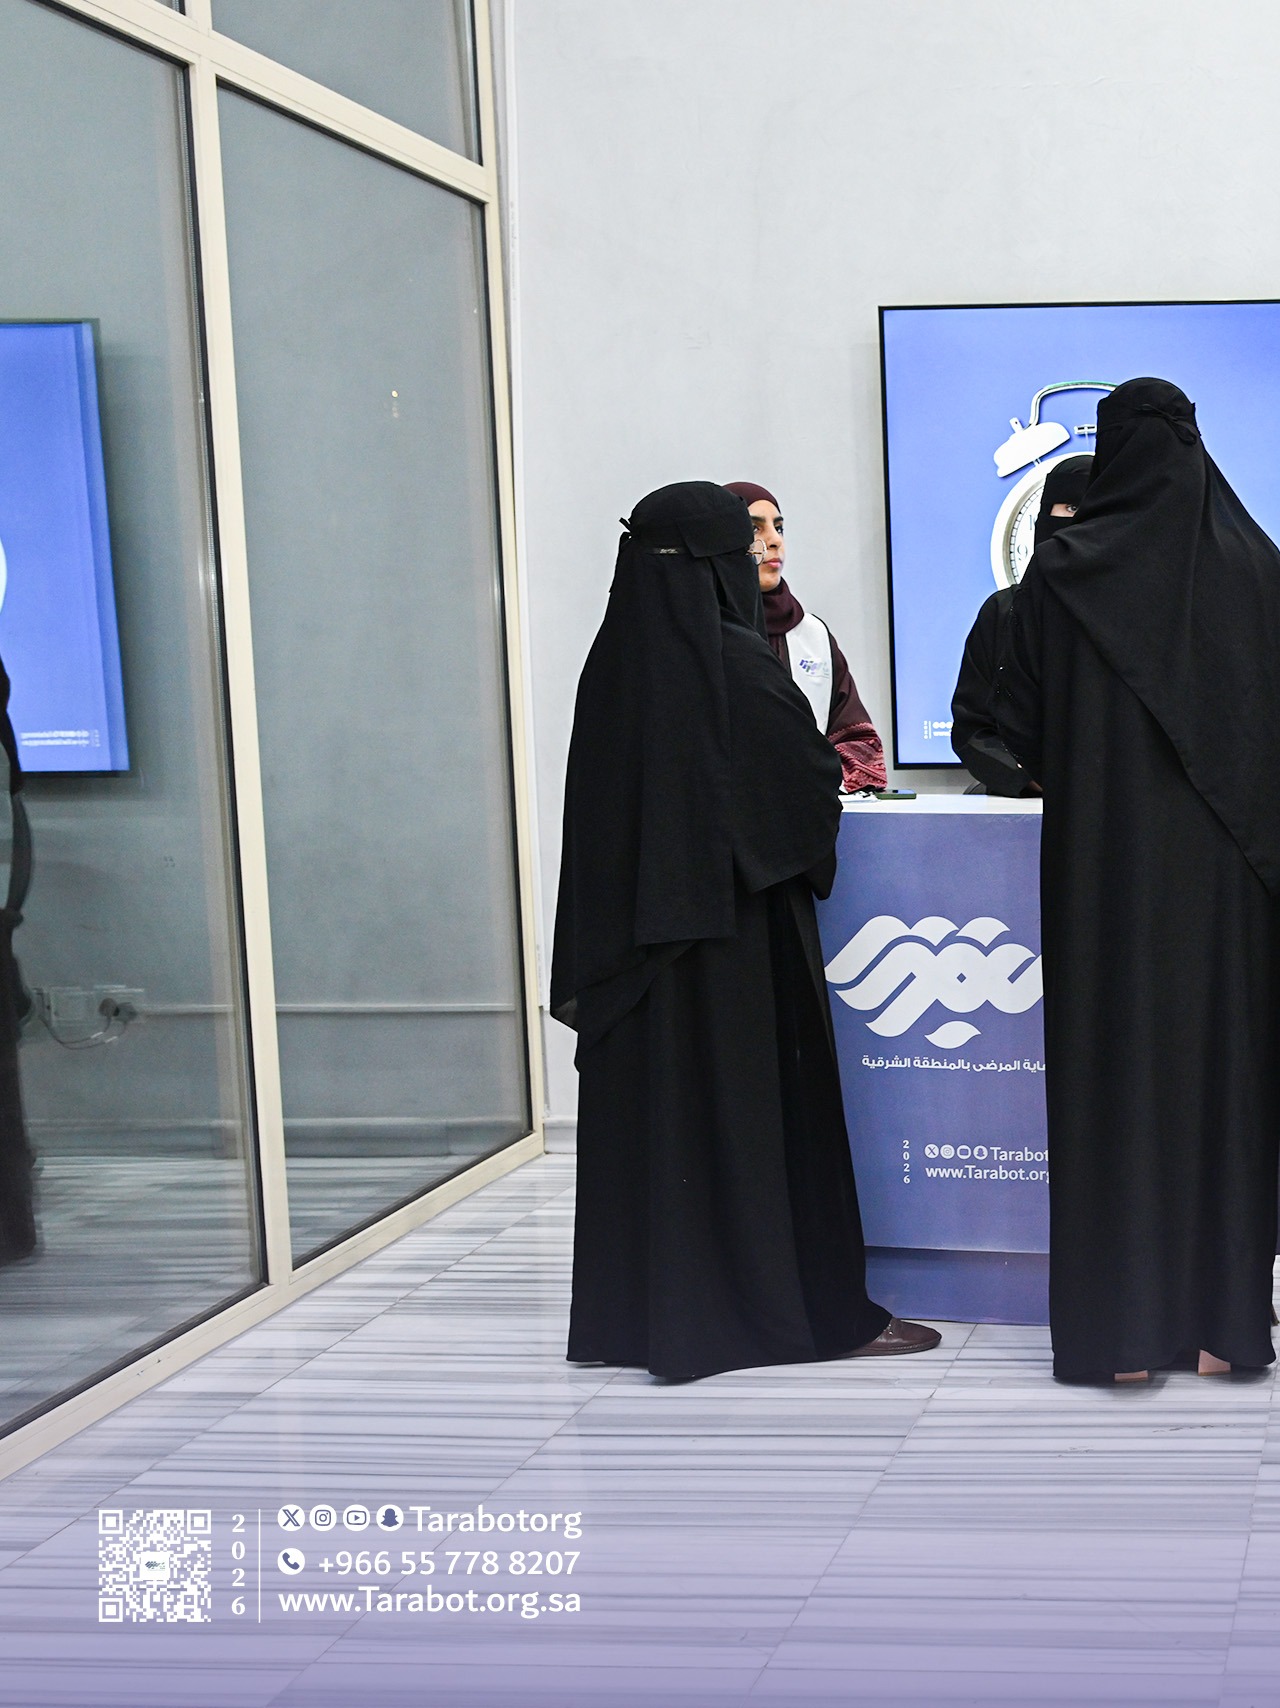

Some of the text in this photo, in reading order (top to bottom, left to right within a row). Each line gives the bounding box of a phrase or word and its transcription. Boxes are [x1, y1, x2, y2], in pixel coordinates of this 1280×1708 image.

[861, 1055, 911, 1070] الشرقية
[913, 1056, 970, 1072] بالمنطقة
[972, 1058, 1020, 1073] المرضى
[990, 1147, 1049, 1162] Tarabot
[925, 1165, 1050, 1184] www.Tarabot.or
